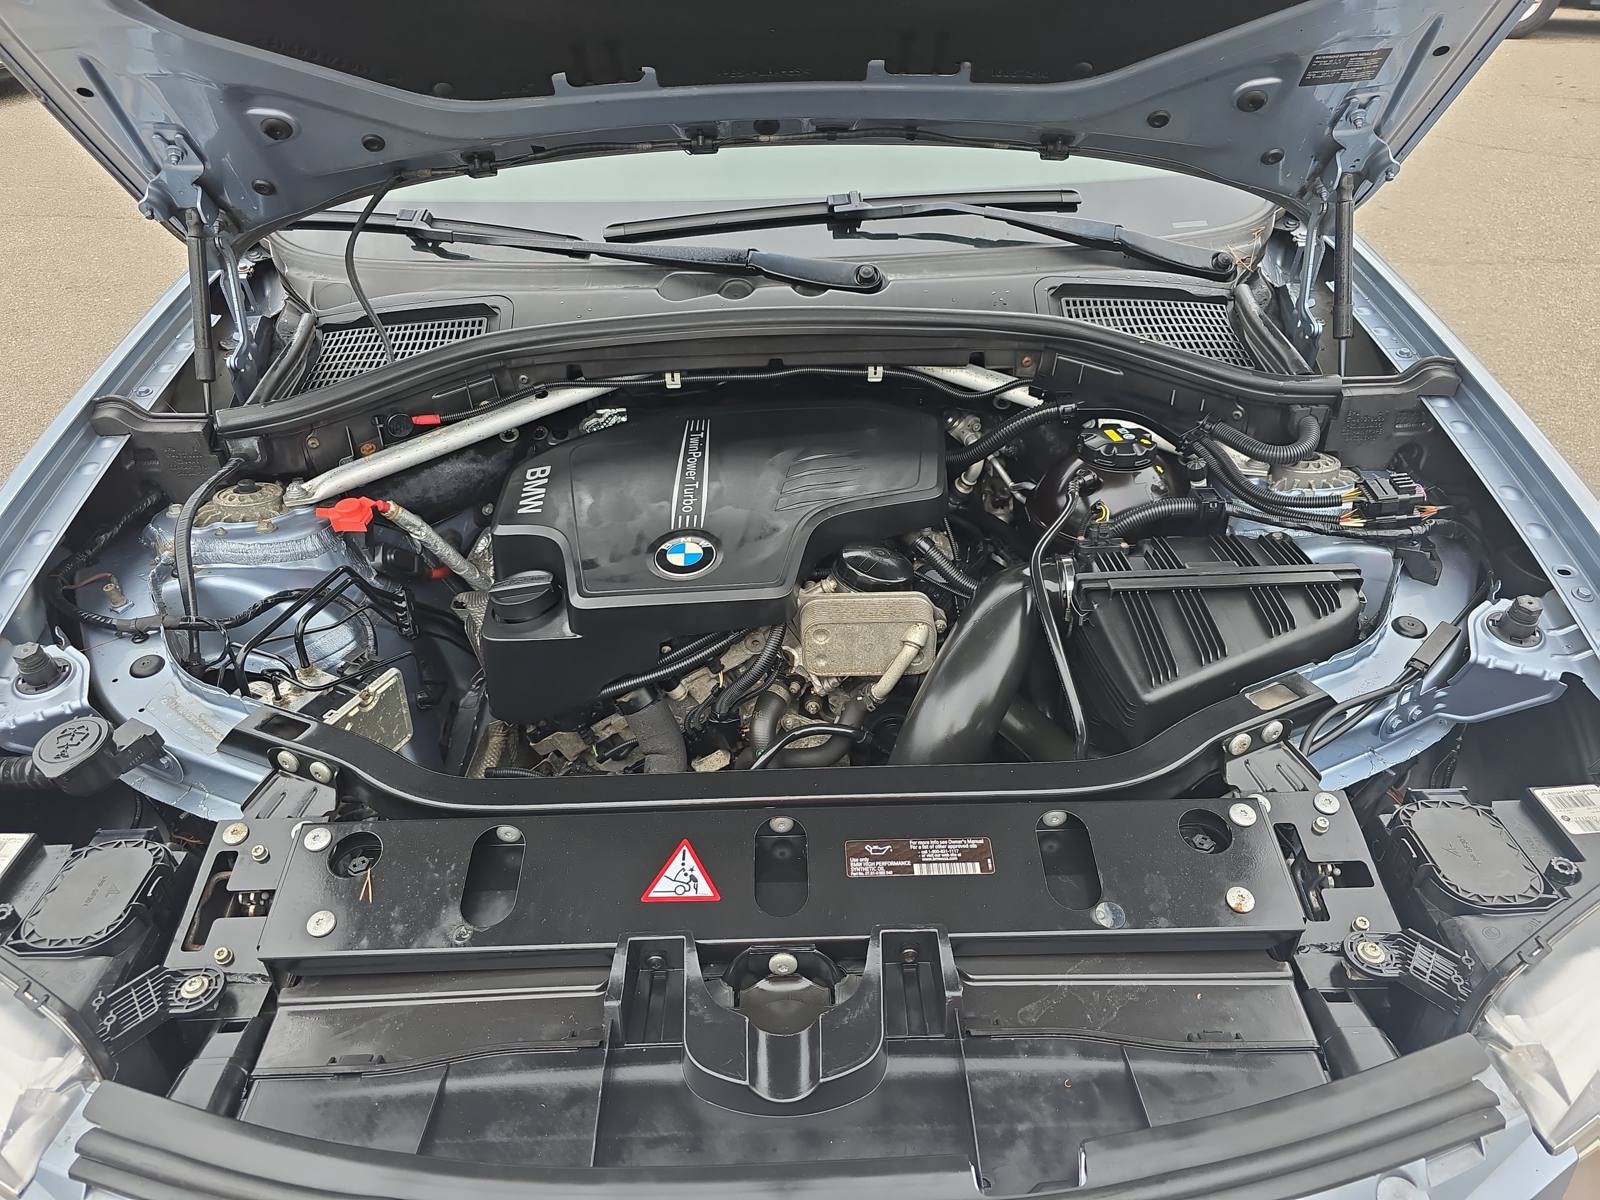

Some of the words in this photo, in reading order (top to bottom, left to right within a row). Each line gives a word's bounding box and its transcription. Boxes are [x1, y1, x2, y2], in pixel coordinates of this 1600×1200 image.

[685, 432, 704, 481] TwinPower
[517, 465, 551, 514] BMW
[681, 481, 699, 513] Turbo
